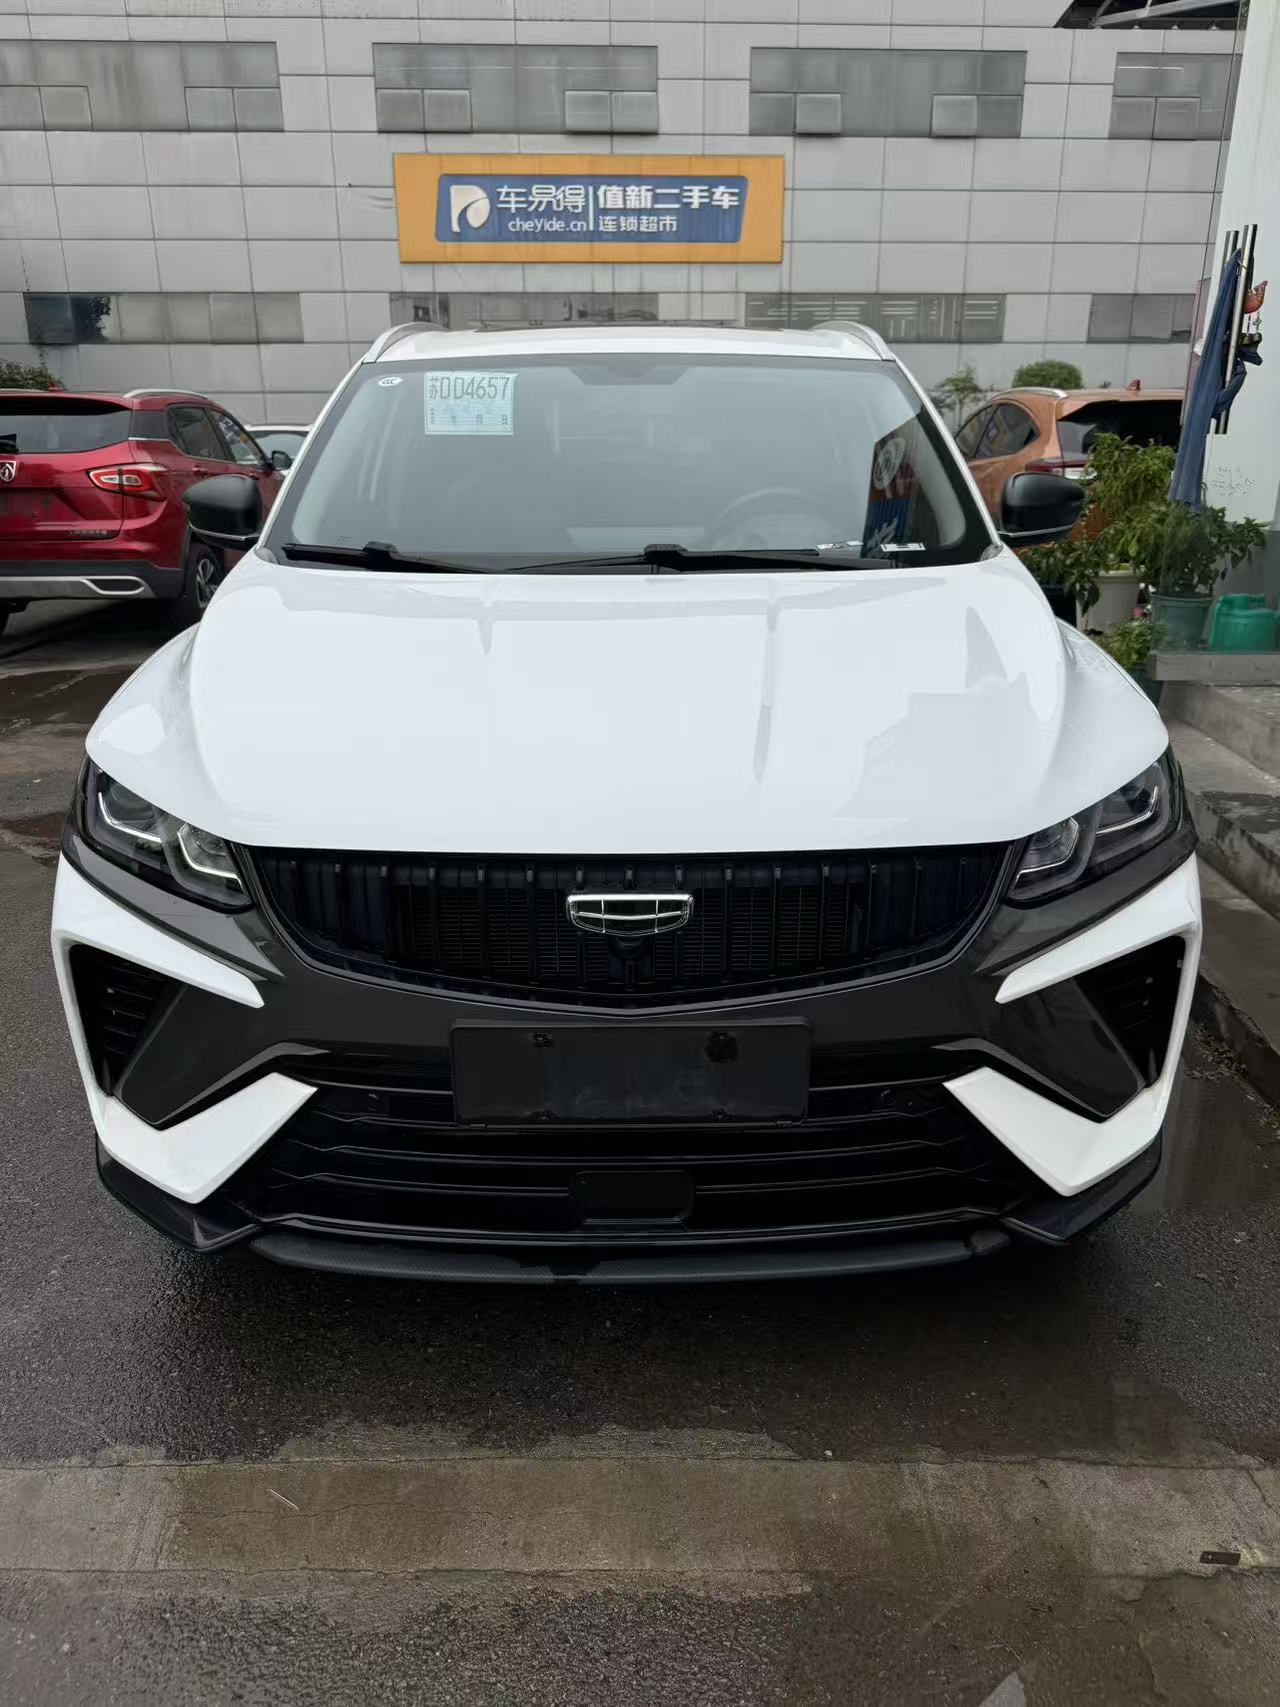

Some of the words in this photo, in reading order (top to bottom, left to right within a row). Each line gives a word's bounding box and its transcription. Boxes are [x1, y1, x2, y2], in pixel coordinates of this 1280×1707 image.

[496, 185, 586, 213] 车易得
[597, 185, 740, 210] 值新二手车
[598, 215, 678, 232] 连锁超市
